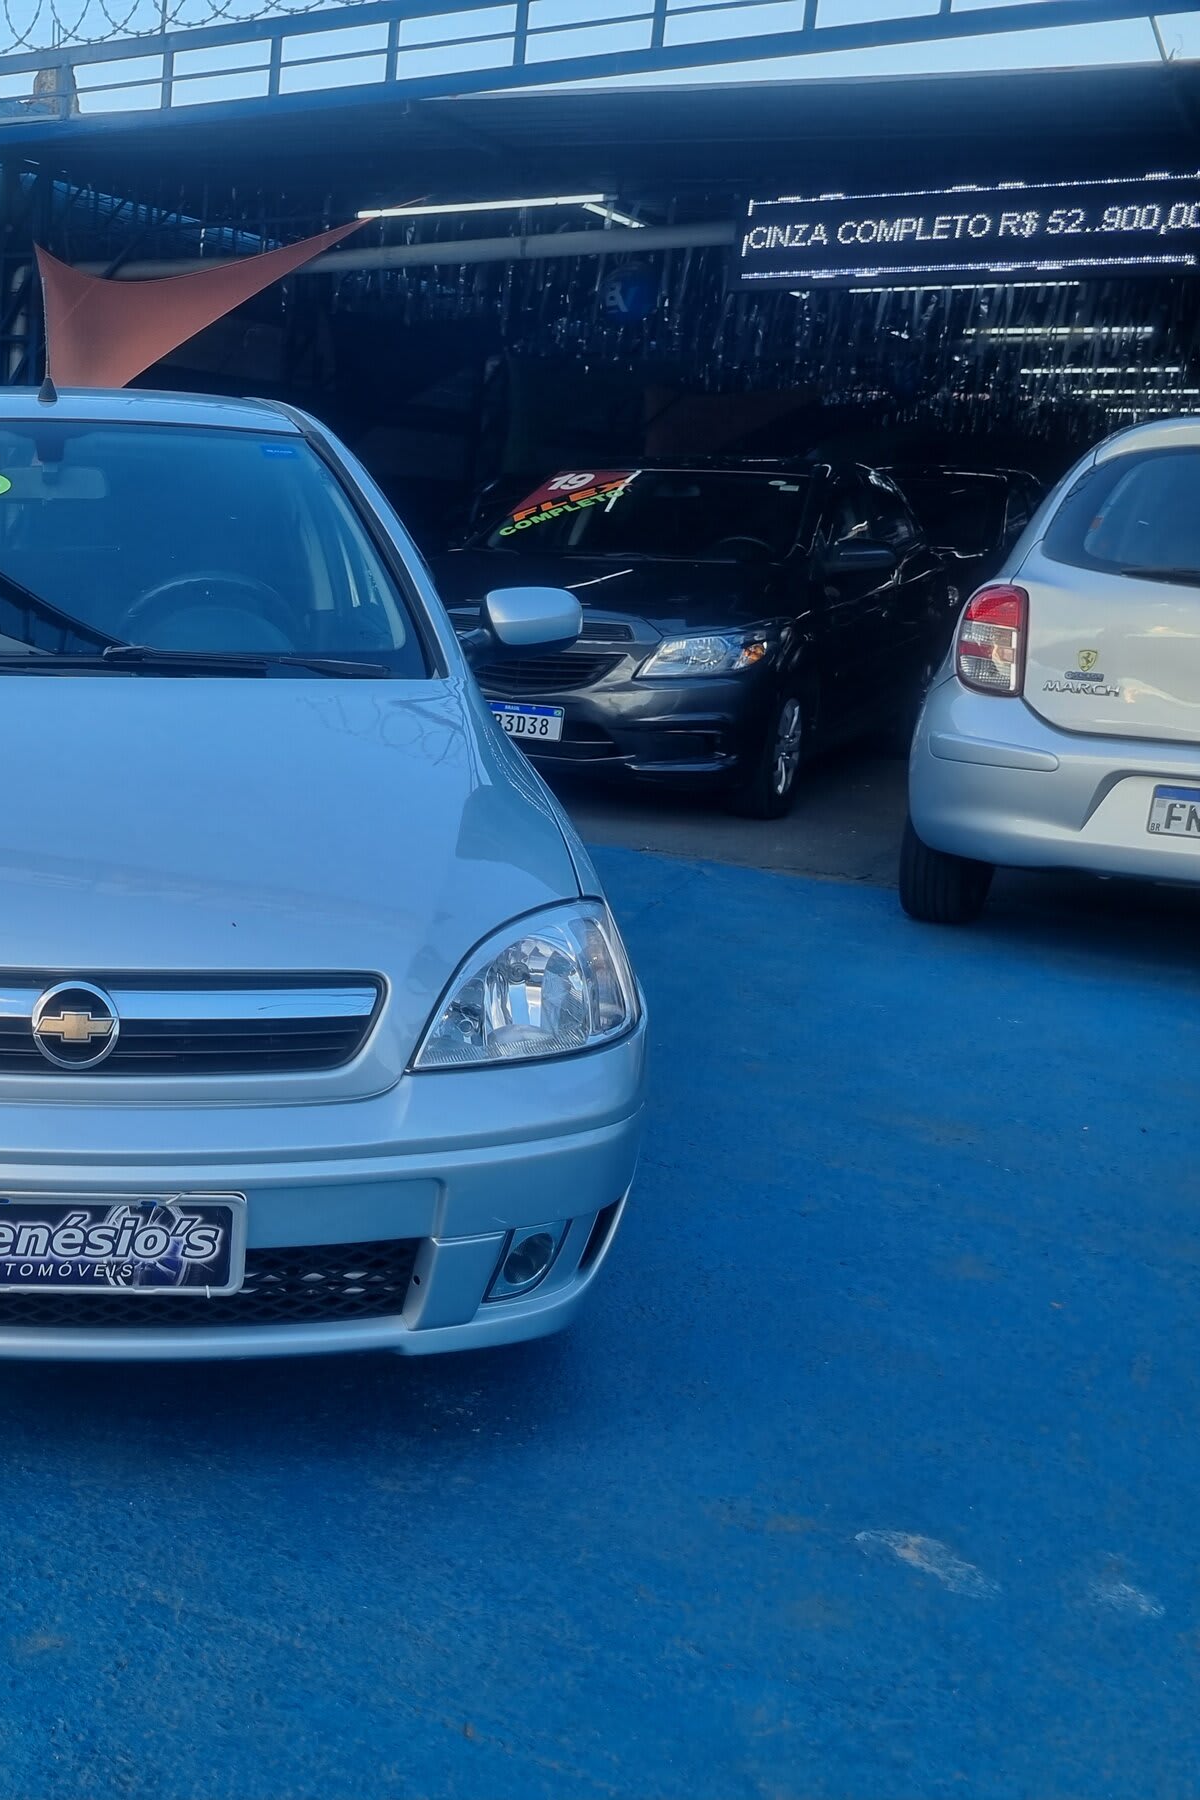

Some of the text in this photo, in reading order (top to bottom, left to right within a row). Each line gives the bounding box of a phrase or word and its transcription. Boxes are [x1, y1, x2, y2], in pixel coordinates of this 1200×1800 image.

[749, 222, 828, 249] CINZA
[837, 212, 992, 245] COMPLETO
[998, 211, 1041, 238] R$
[512, 478, 630, 522] FLEX
[548, 473, 595, 491] 19
[499, 489, 625, 536] COMPLETO
[1042, 680, 1120, 697] MARCH
